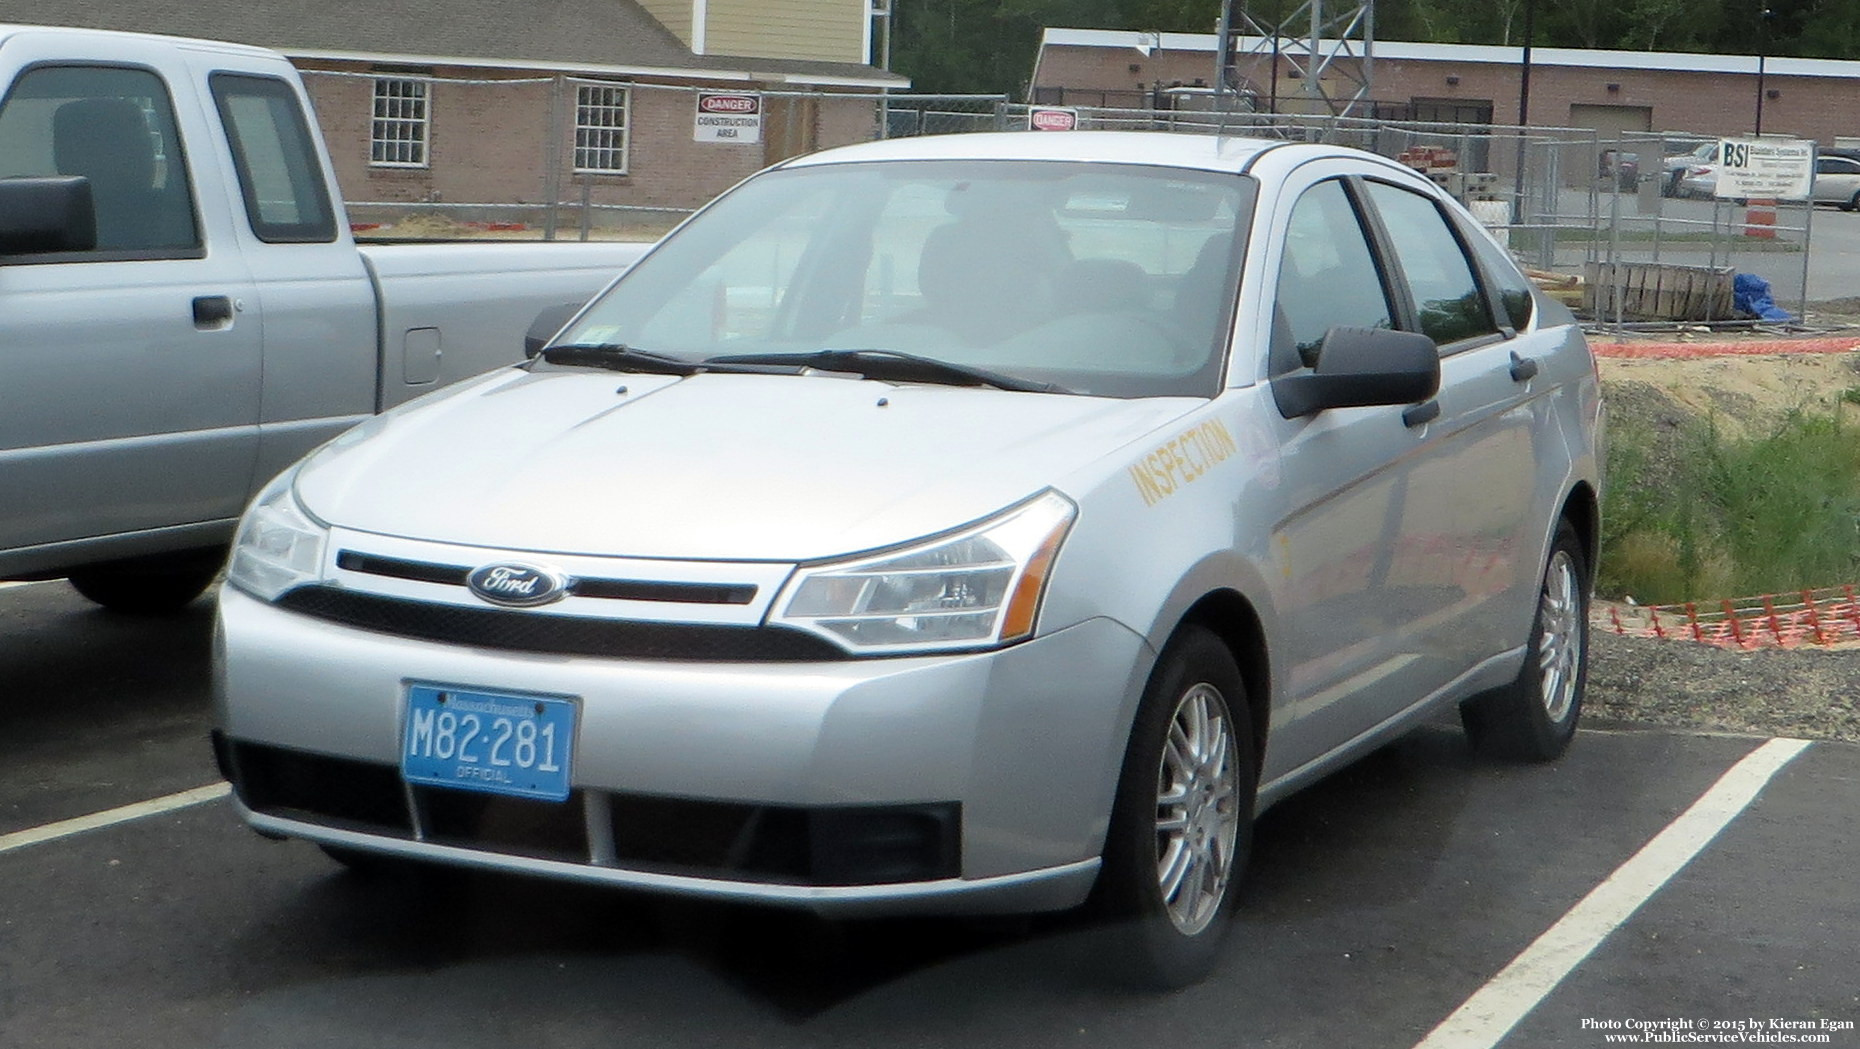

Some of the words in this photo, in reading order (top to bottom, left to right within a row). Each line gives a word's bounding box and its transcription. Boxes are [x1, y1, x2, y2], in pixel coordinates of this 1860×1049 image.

[707, 99, 752, 110] DANGER
[697, 117, 759, 127] CONSTRUCTION
[1036, 114, 1072, 127] DANGER
[716, 128, 738, 138] AREA
[1724, 142, 1750, 168] BSI
[1128, 417, 1237, 507] INSPECTION
[483, 566, 540, 594] Ford
[456, 765, 512, 784] OFFICIAL
